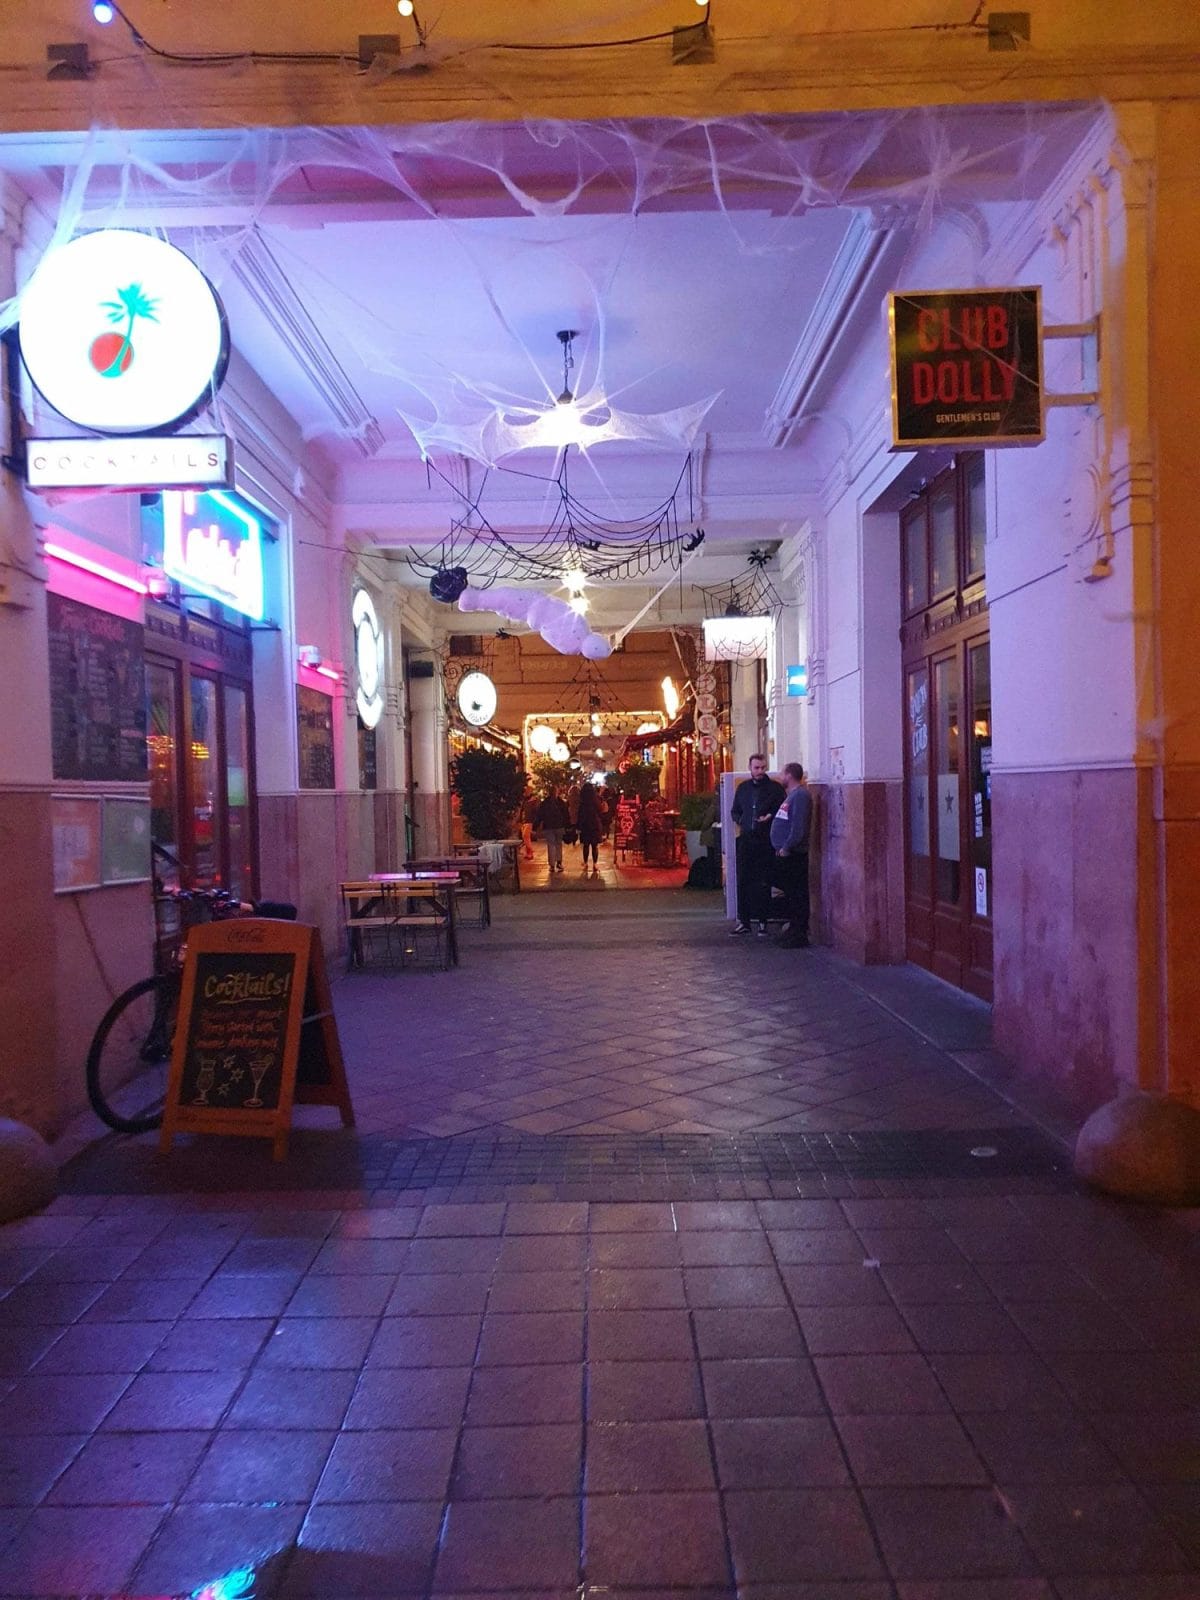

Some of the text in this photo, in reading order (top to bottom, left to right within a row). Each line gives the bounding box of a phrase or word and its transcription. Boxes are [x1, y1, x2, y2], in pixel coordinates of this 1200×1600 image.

[918, 305, 1010, 353] CLUB
[911, 360, 1019, 406] DOLLY
[936, 411, 1001, 424] GENTLEMEN'S CLUB
[33, 452, 219, 471] COCKTAILS
[204, 972, 291, 1000] Cocktails!
